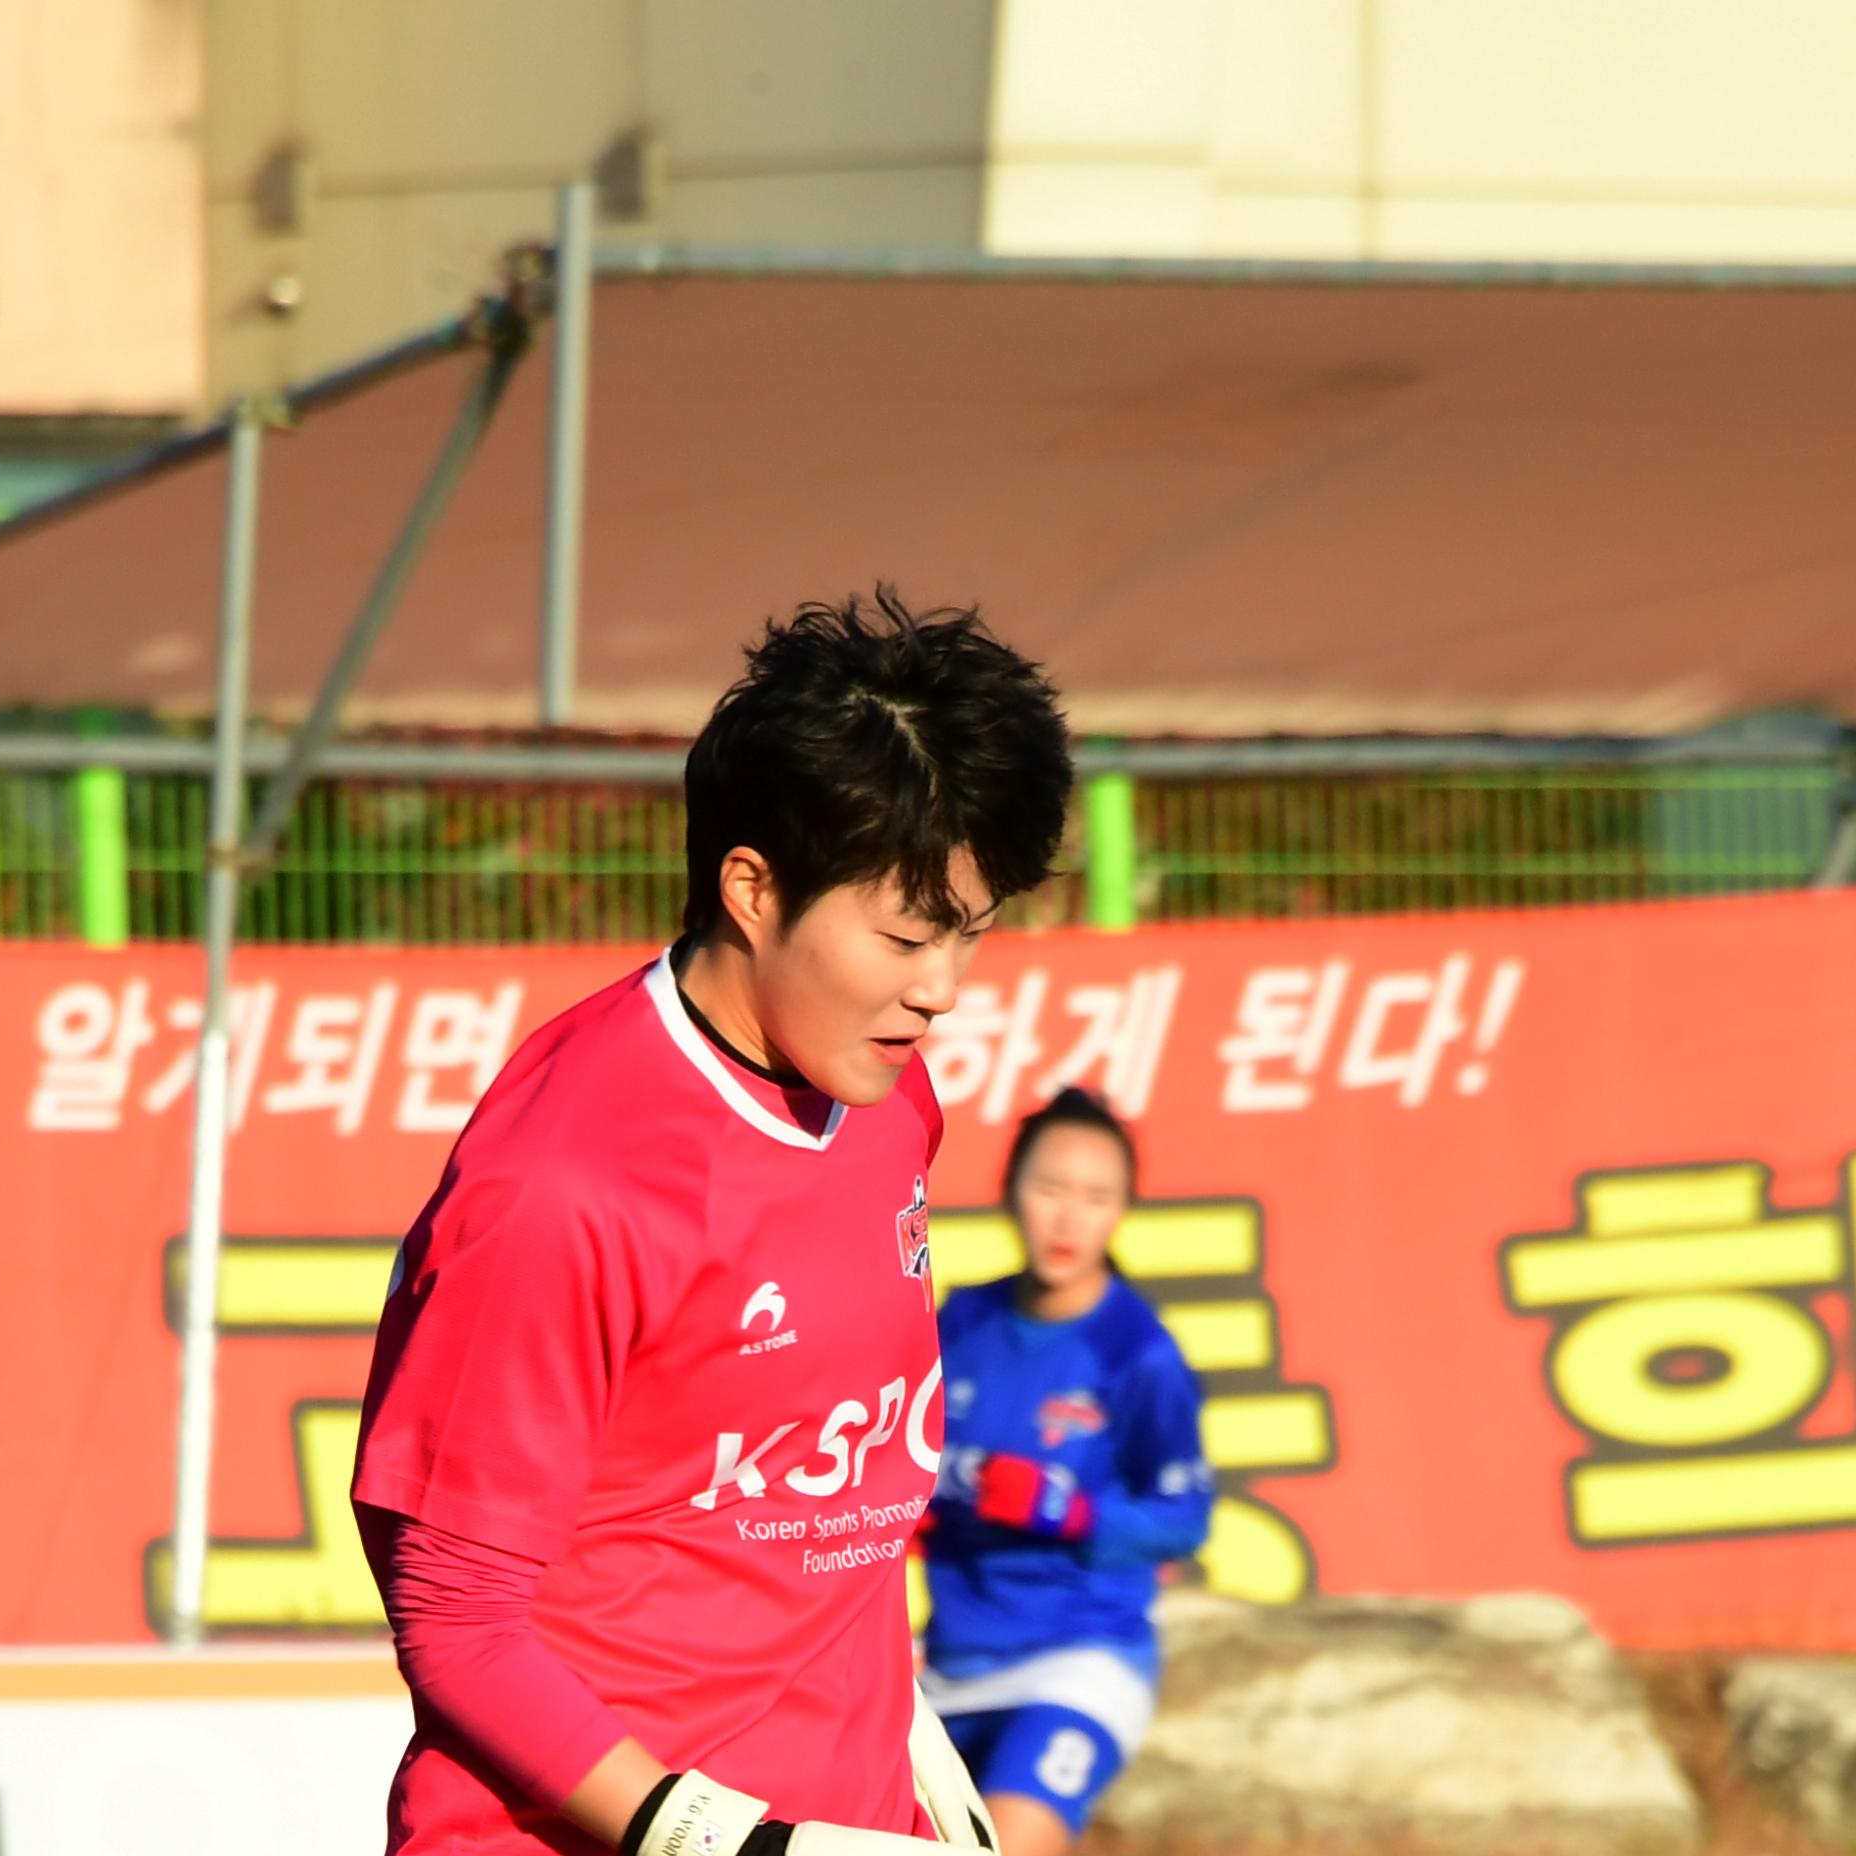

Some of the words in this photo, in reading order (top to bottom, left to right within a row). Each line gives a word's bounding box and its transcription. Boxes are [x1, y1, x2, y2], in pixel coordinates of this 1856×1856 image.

[1217, 952, 1525, 1116] 된다!
[738, 1329, 798, 1356] ASTORE
[735, 1519, 806, 1541] Korea
[812, 1512, 859, 1543] Sports
[802, 1539, 905, 1575] Foundation
